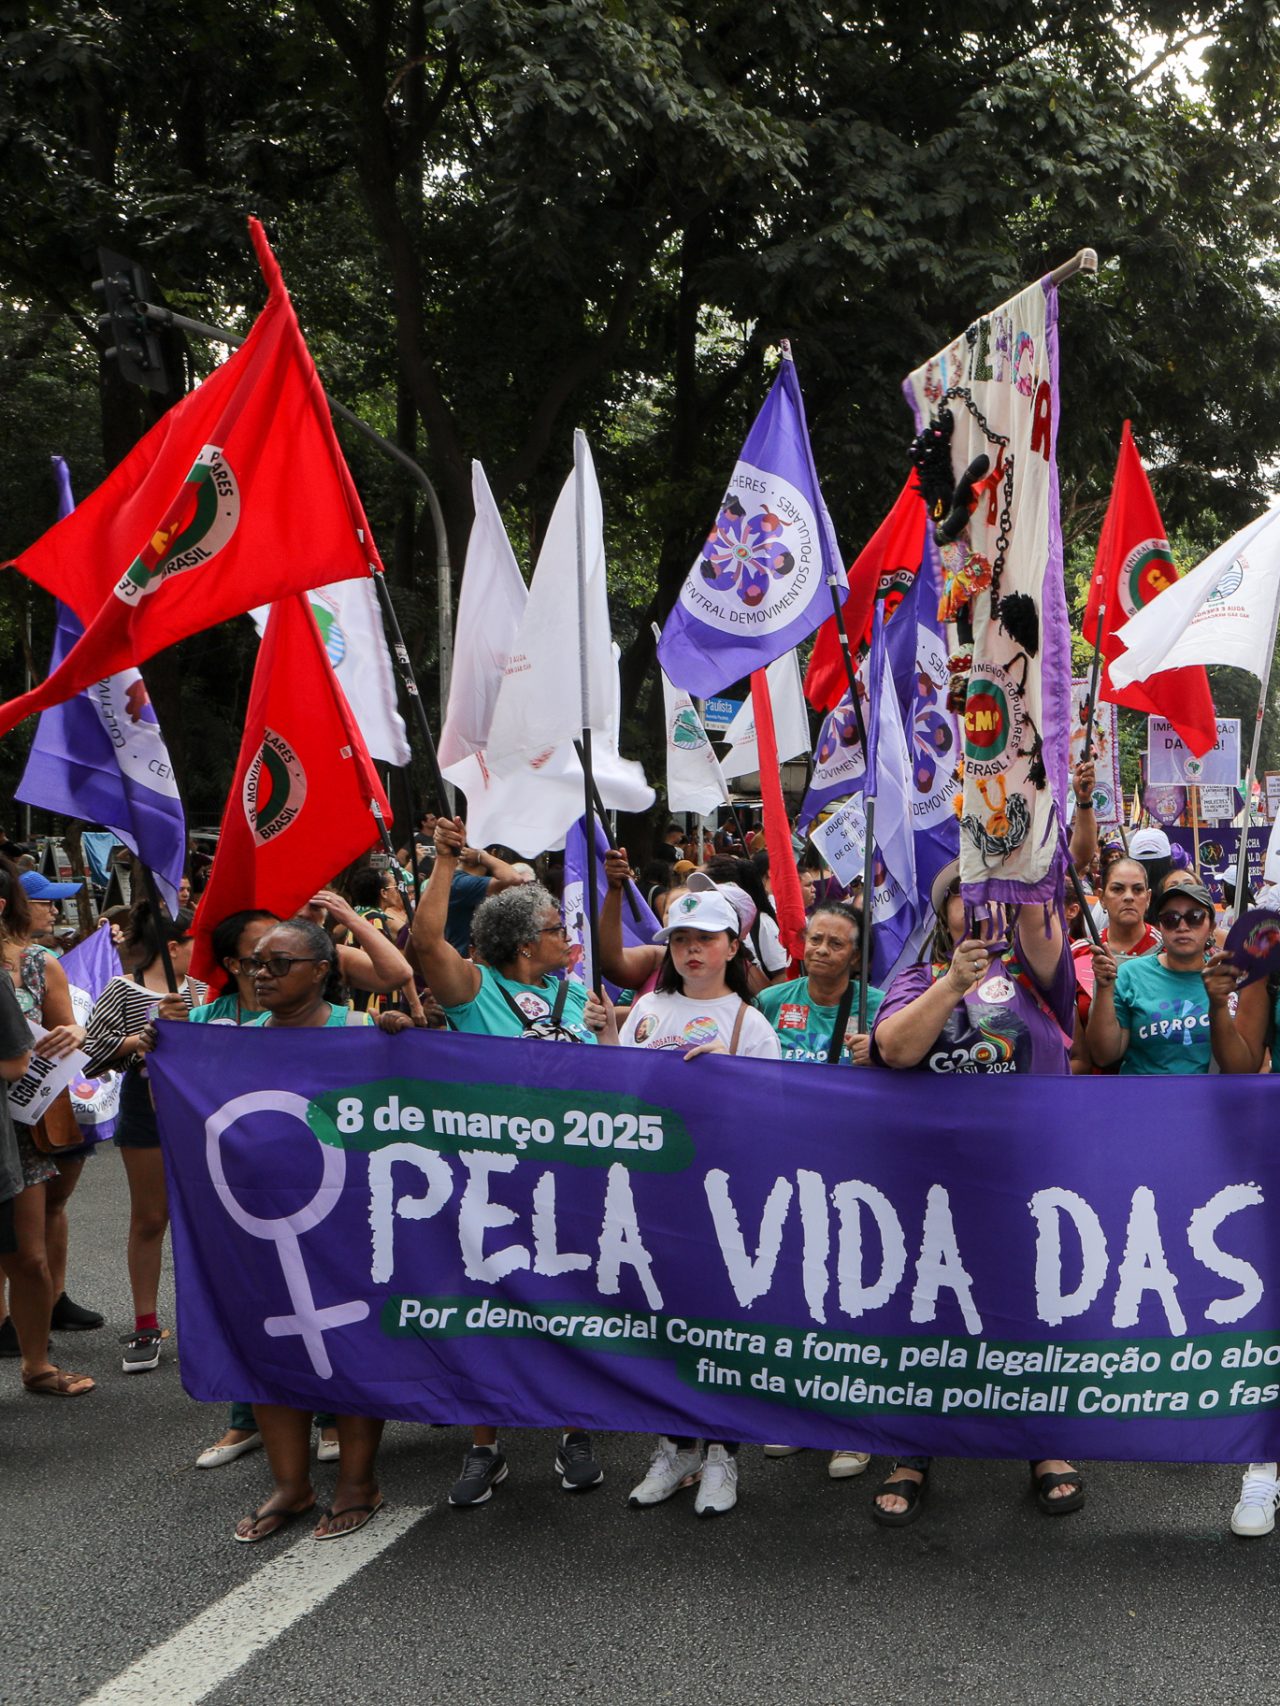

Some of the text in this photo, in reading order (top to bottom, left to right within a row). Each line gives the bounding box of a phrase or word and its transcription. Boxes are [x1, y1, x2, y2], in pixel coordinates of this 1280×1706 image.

[705, 700, 733, 713] Paulista
[964, 710, 999, 732] CMP
[1165, 738, 1183, 750] DA
[259, 806, 299, 840] BRASIL
[986, 1060, 1016, 1074] 2024
[8, 1073, 43, 1108] LEGAL
[337, 1096, 664, 1151] 8 de março 2025
[368, 1142, 663, 1311] PELA
[704, 1168, 983, 1336] VIDA
[1027, 1180, 1265, 1337] DAS
[400, 1299, 457, 1328] Por
[466, 1300, 658, 1339] democracia!
[667, 1318, 766, 1354] Contra
[775, 1338, 793, 1358] a
[803, 1332, 889, 1369] fome,
[899, 1341, 968, 1371] pela
[977, 1343, 1160, 1379] legalização
[1171, 1342, 1213, 1371] do
[697, 1358, 741, 1386] fim
[751, 1366, 785, 1393] da
[795, 1375, 933, 1407] violência
[943, 1383, 1069, 1412] policial!
[1078, 1386, 1188, 1413] Contra
[1199, 1389, 1220, 1409] o
